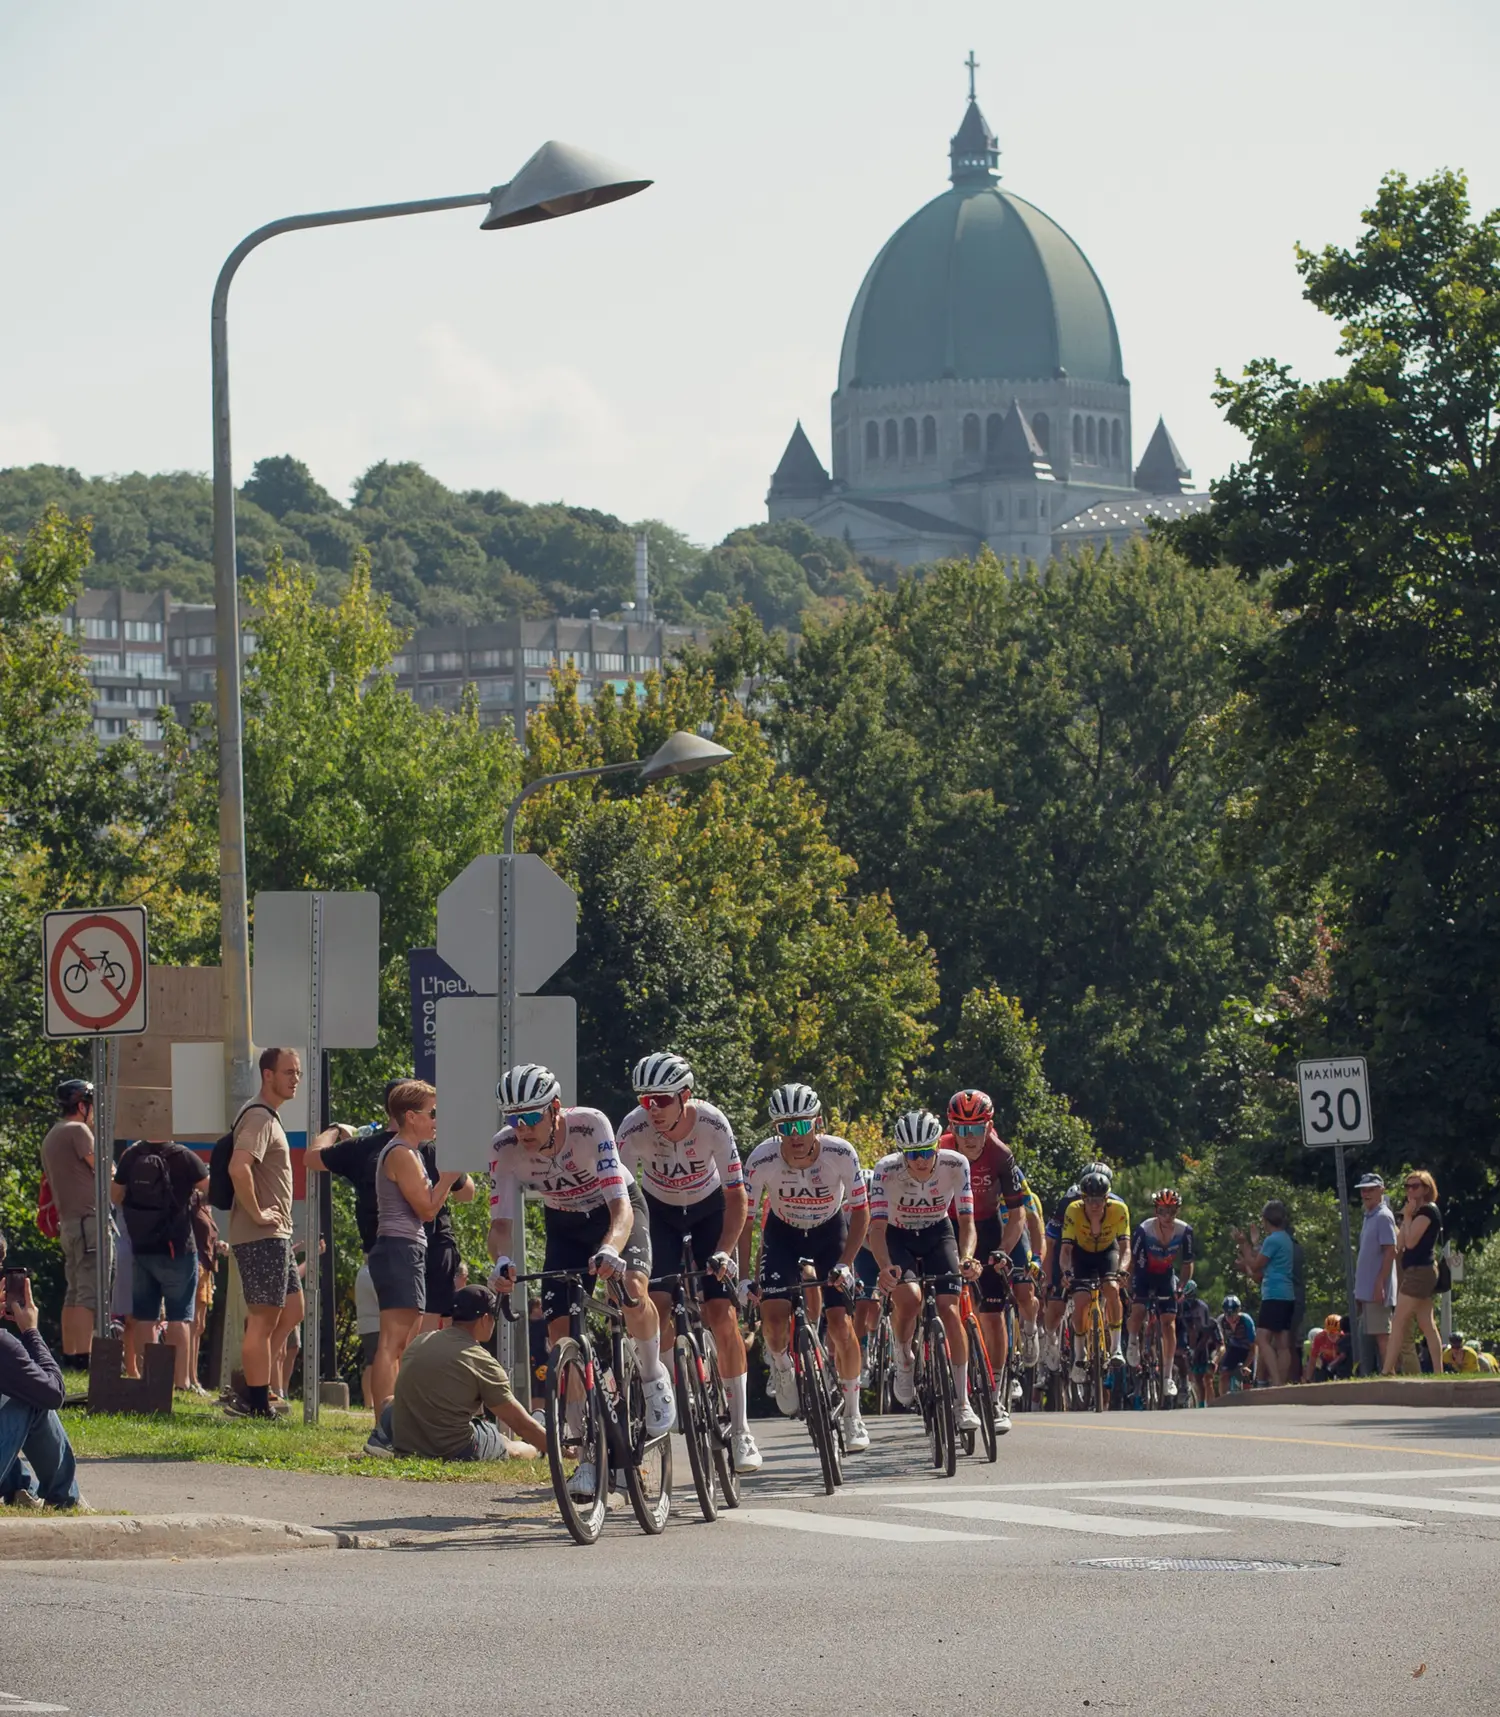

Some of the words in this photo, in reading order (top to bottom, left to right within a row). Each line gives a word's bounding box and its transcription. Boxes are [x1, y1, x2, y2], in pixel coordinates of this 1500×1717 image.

[1304, 1067, 1360, 1080] MAXIMUM
[1310, 1087, 1362, 1133] 30
[652, 1160, 706, 1178] UAE
[778, 1186, 831, 1199] UAE
[900, 1196, 945, 1208] UAE
